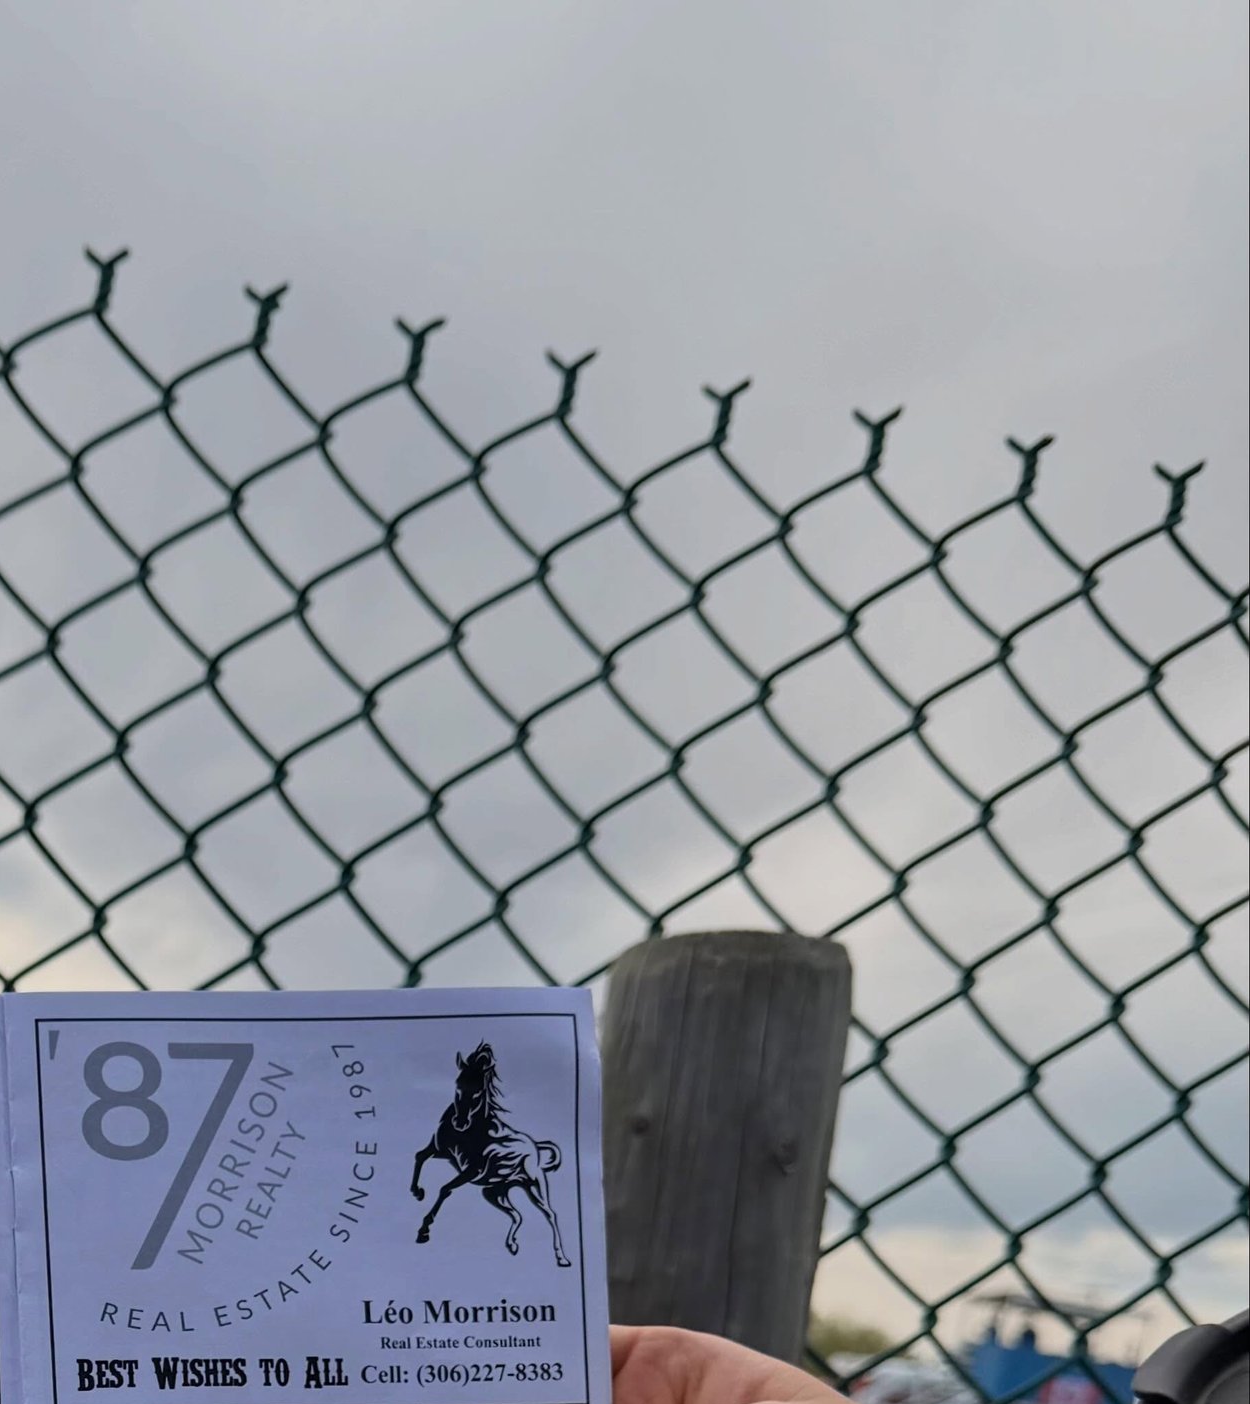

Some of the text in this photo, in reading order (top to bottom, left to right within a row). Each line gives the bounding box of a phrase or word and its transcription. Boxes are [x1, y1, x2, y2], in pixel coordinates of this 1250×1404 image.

[49, 1031, 254, 1270] '87
[101, 1045, 377, 1332] REAL ESTATE SINCE 1987
[177, 1061, 295, 1264] MORRISON
[236, 1121, 306, 1239] REALTY
[363, 1299, 555, 1324] Léo Morrison
[381, 1336, 540, 1349] Real Estate Consultant
[77, 1357, 348, 1391] BEST WISHES TO ALL
[361, 1363, 562, 1386] Cell: (306)227-8383
